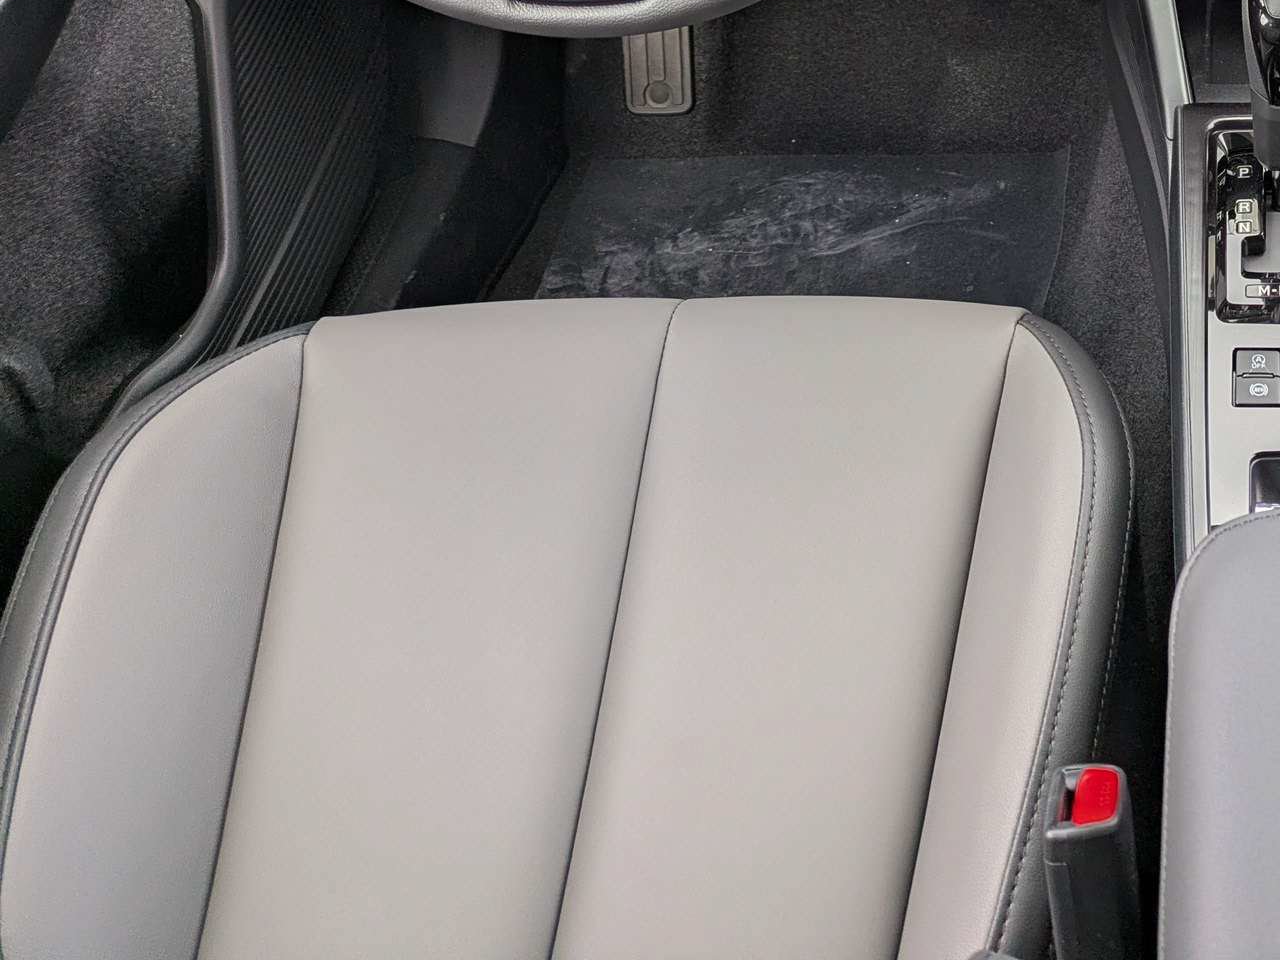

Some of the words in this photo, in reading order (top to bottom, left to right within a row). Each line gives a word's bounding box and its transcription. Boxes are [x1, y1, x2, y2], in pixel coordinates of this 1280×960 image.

[1240, 168, 1249, 177] P
[1240, 202, 1250, 213] R
[1240, 221, 1251, 233] N
